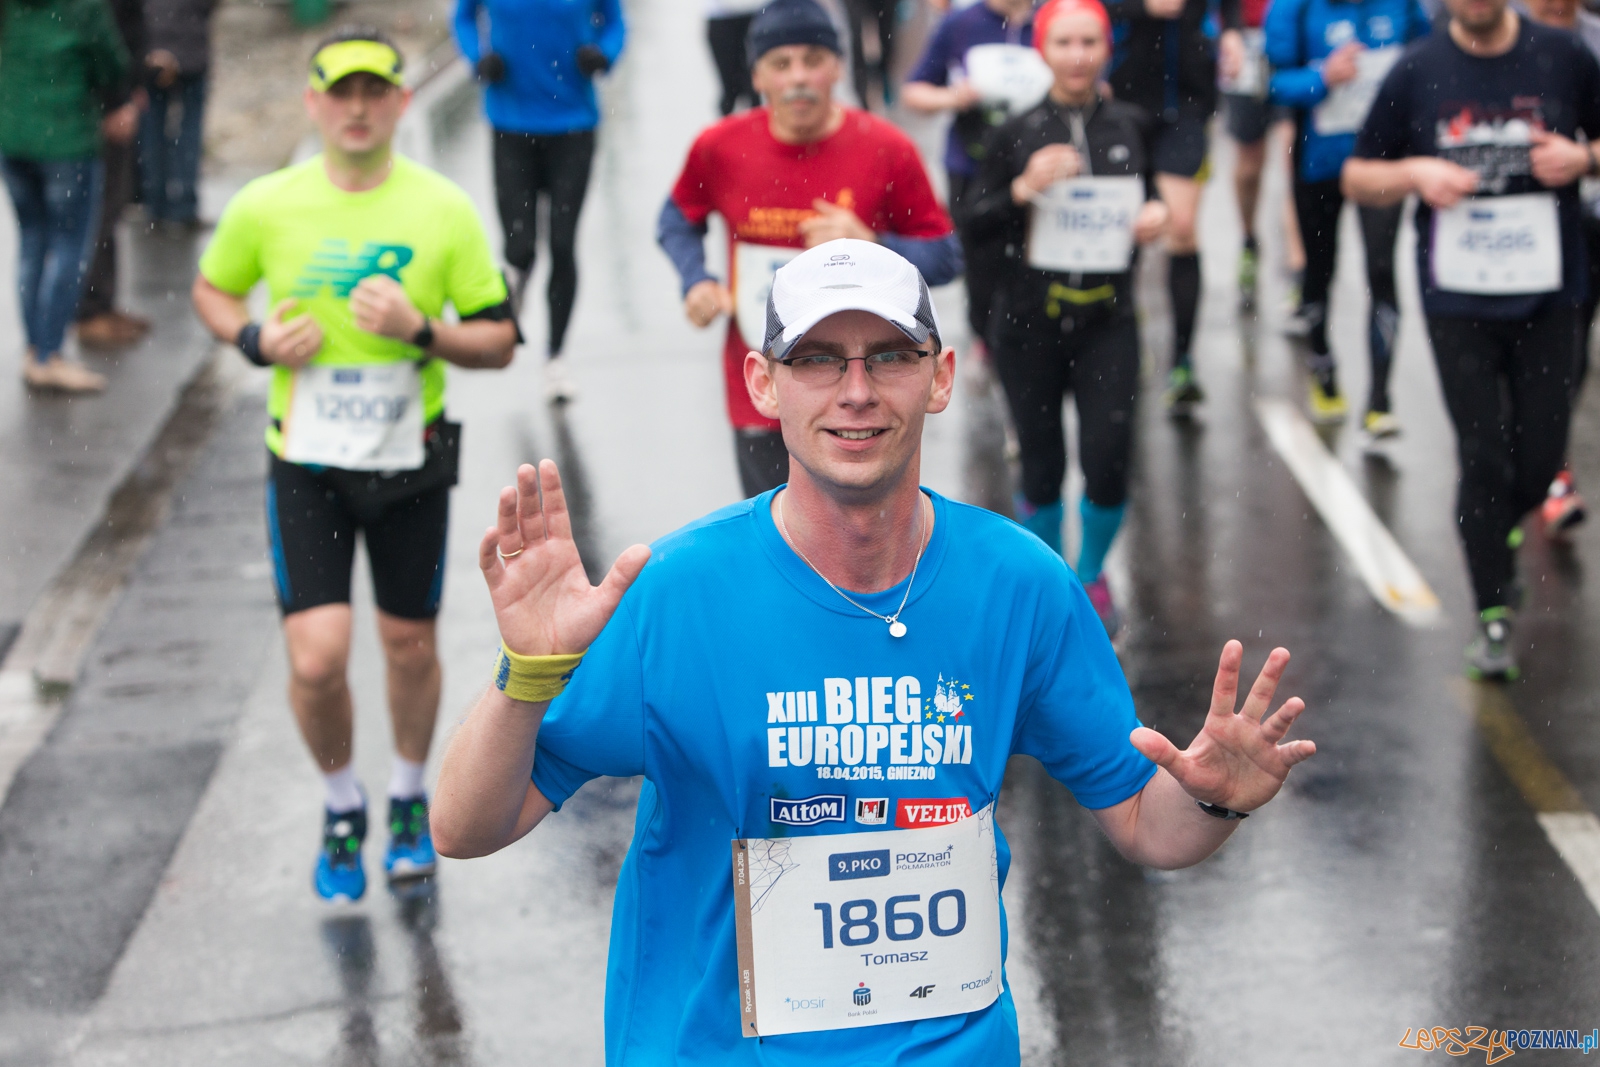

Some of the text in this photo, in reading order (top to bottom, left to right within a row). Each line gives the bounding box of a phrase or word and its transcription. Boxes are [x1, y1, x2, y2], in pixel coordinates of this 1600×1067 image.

[766, 675, 922, 725] XIII BIEG
[767, 724, 973, 768] EUROPEJSKI
[816, 766, 936, 781] 18.04.2015, GNIEZNO
[904, 803, 968, 823] VELUX
[737, 852, 745, 885] 17.04.2016
[838, 857, 882, 873] 9. PKO
[896, 860, 951, 871] PÓŁMARATON
[813, 888, 967, 949] 1860
[860, 951, 929, 967] Tomasz
[909, 984, 936, 999] 4F
